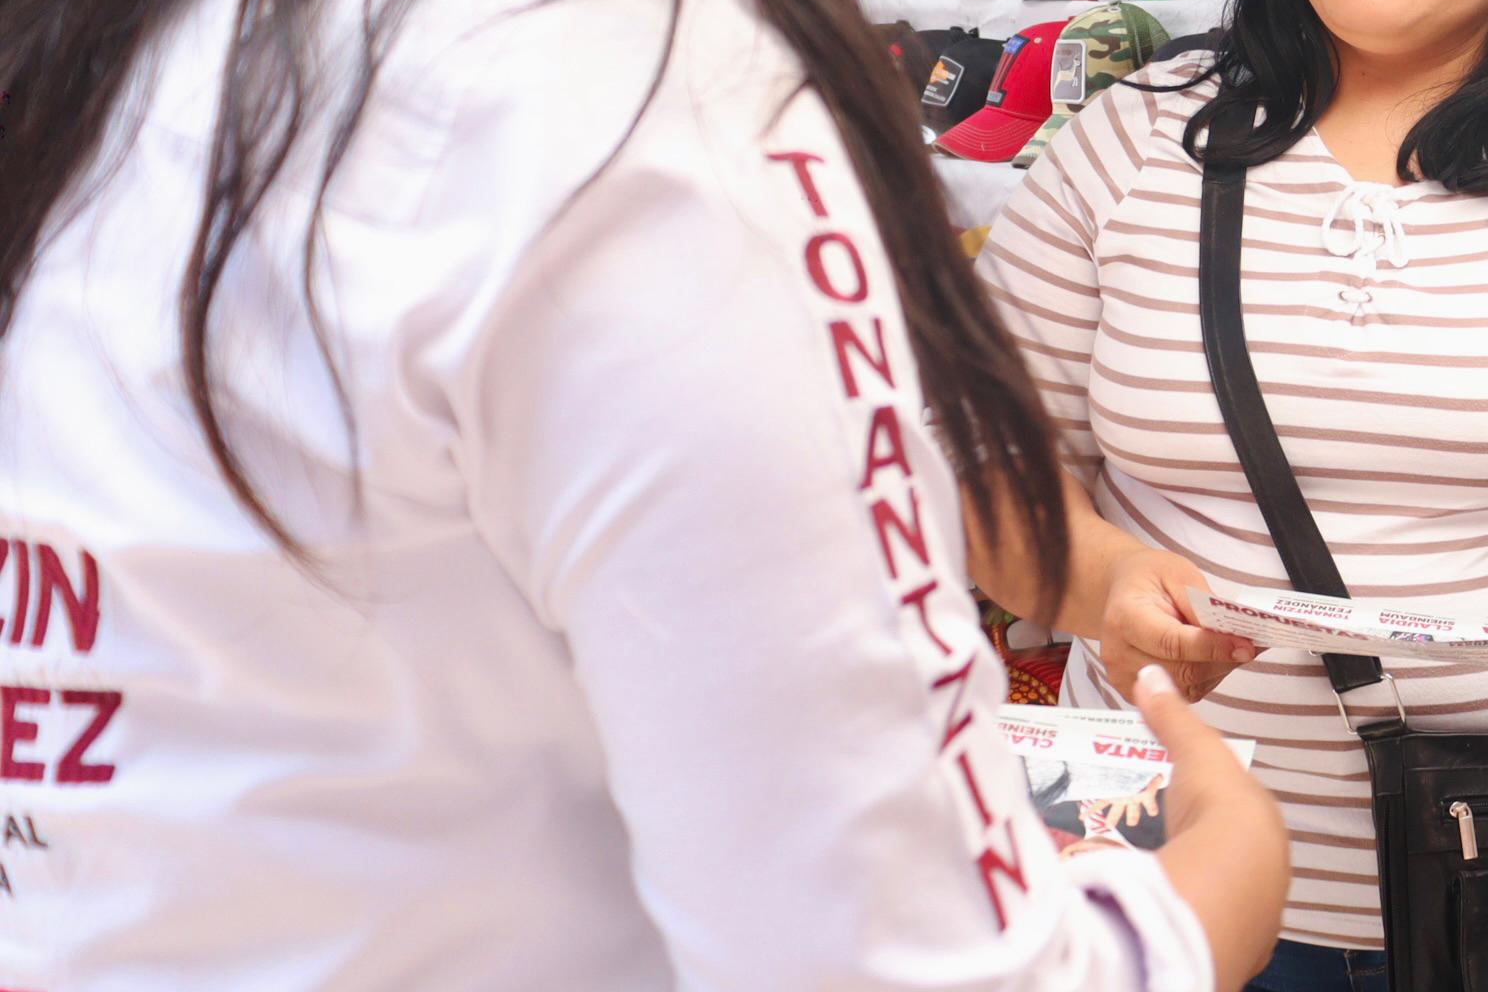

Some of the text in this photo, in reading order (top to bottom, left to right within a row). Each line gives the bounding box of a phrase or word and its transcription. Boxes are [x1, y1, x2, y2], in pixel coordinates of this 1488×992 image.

[766, 150, 1028, 934] TONANTZIN
[1378, 617, 1454, 631] CLAUDIA
[1007, 734, 1054, 749] CLA
[1092, 741, 1168, 762] ENTA
